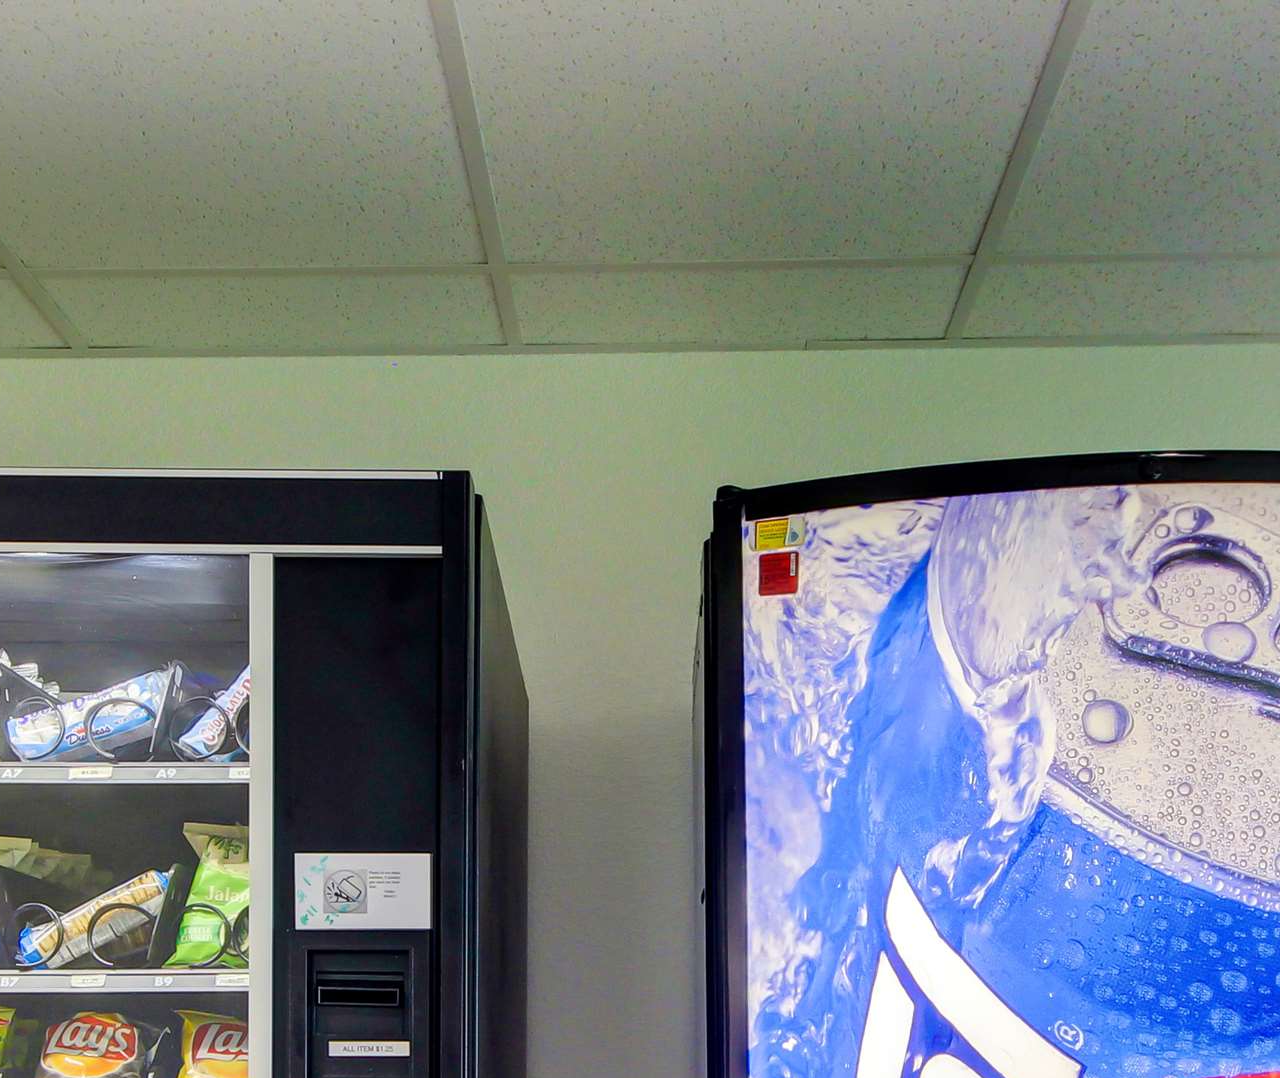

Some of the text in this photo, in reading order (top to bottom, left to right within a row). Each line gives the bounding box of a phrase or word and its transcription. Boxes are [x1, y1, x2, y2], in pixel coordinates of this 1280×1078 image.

[65, 724, 113, 746] Duess
[1, 768, 24, 778] A7
[155, 768, 177, 778] A9
[0, 977, 20, 987] B7
[154, 976, 174, 987] B9
[47, 1021, 131, 1056] Lay's
[342, 1045, 356, 1053] ALL
[357, 1045, 375, 1053] ITEM
